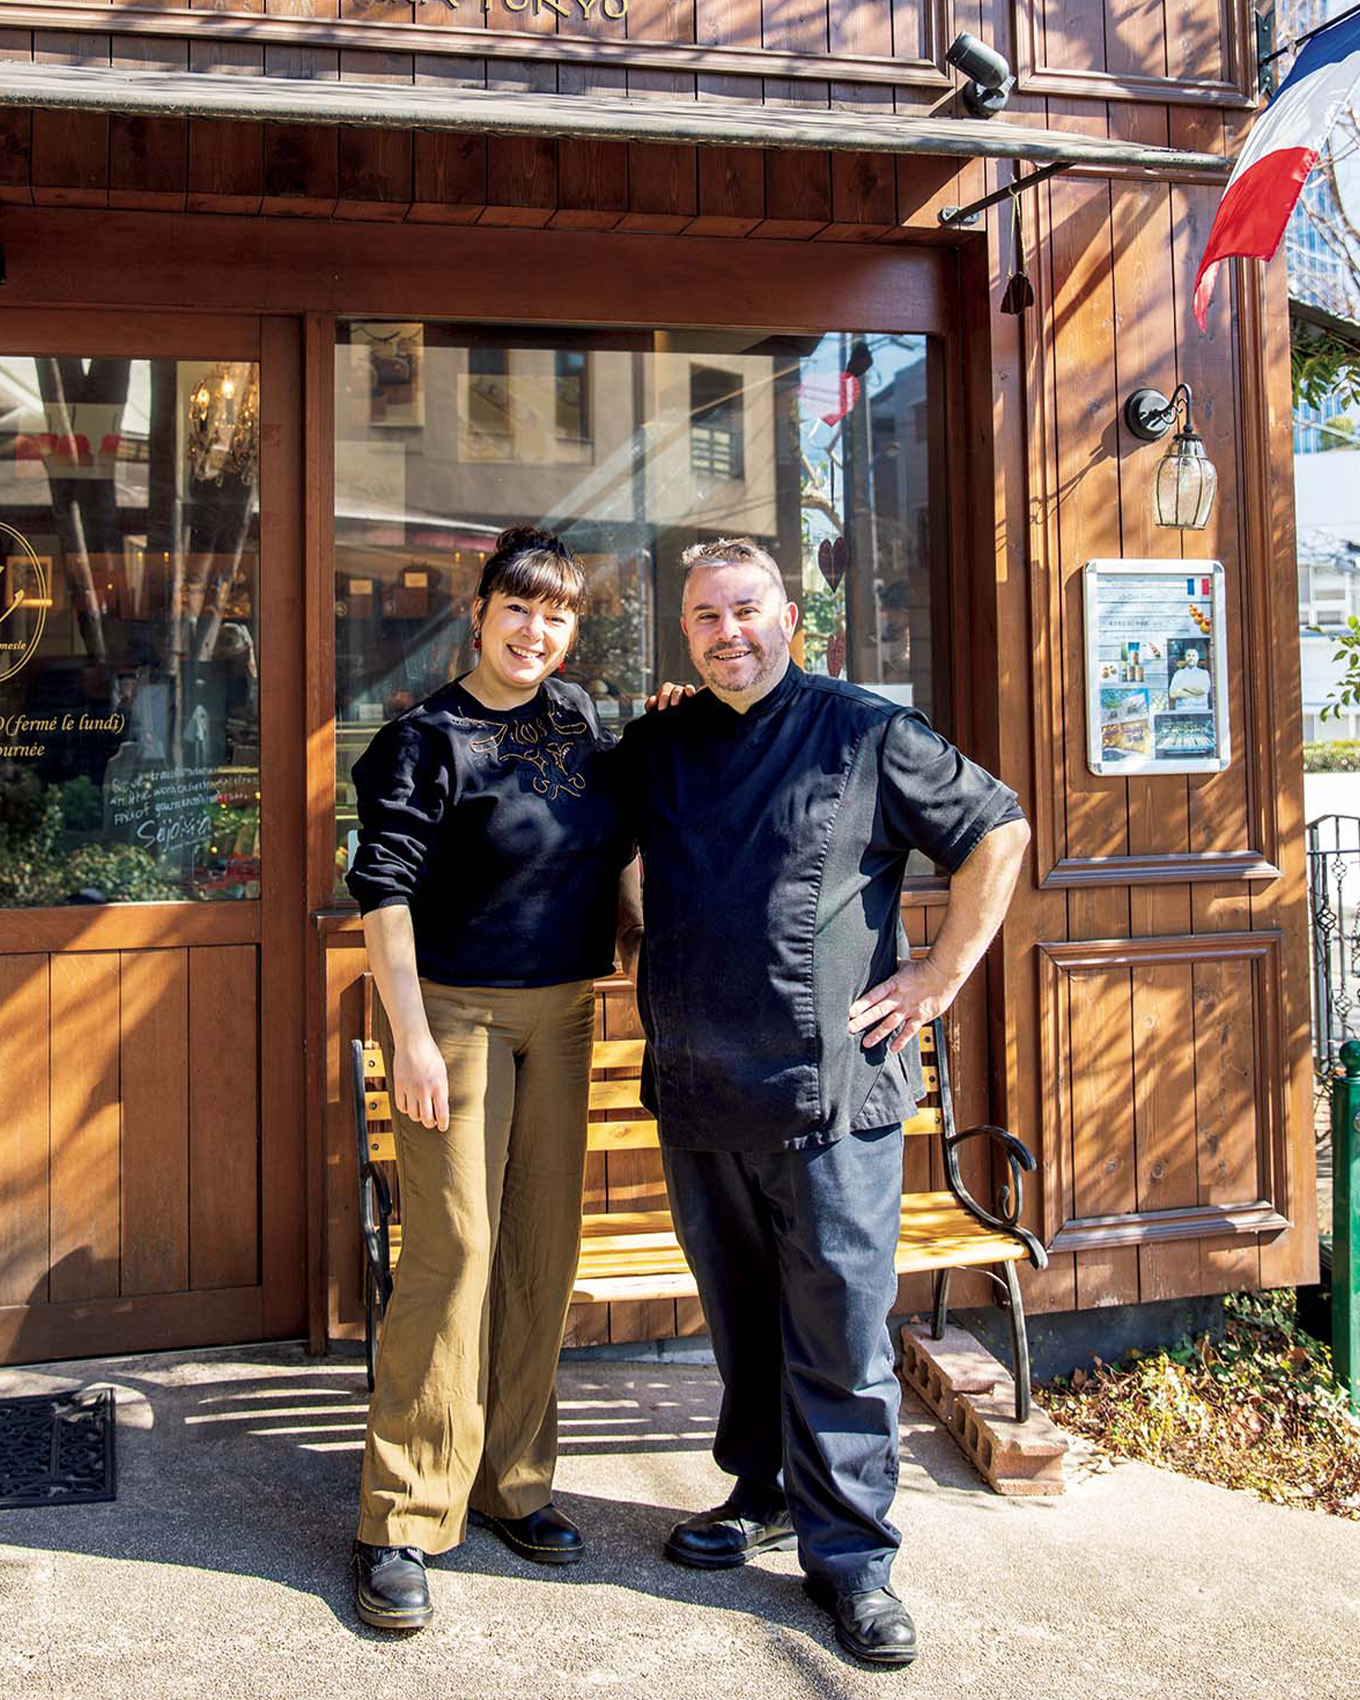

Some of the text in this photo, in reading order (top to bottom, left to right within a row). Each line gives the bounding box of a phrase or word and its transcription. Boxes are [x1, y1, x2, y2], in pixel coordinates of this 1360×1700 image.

[484, 0, 628, 19] KYO
[61, 714, 75, 731] le
[78, 713, 125, 735] lundi)
